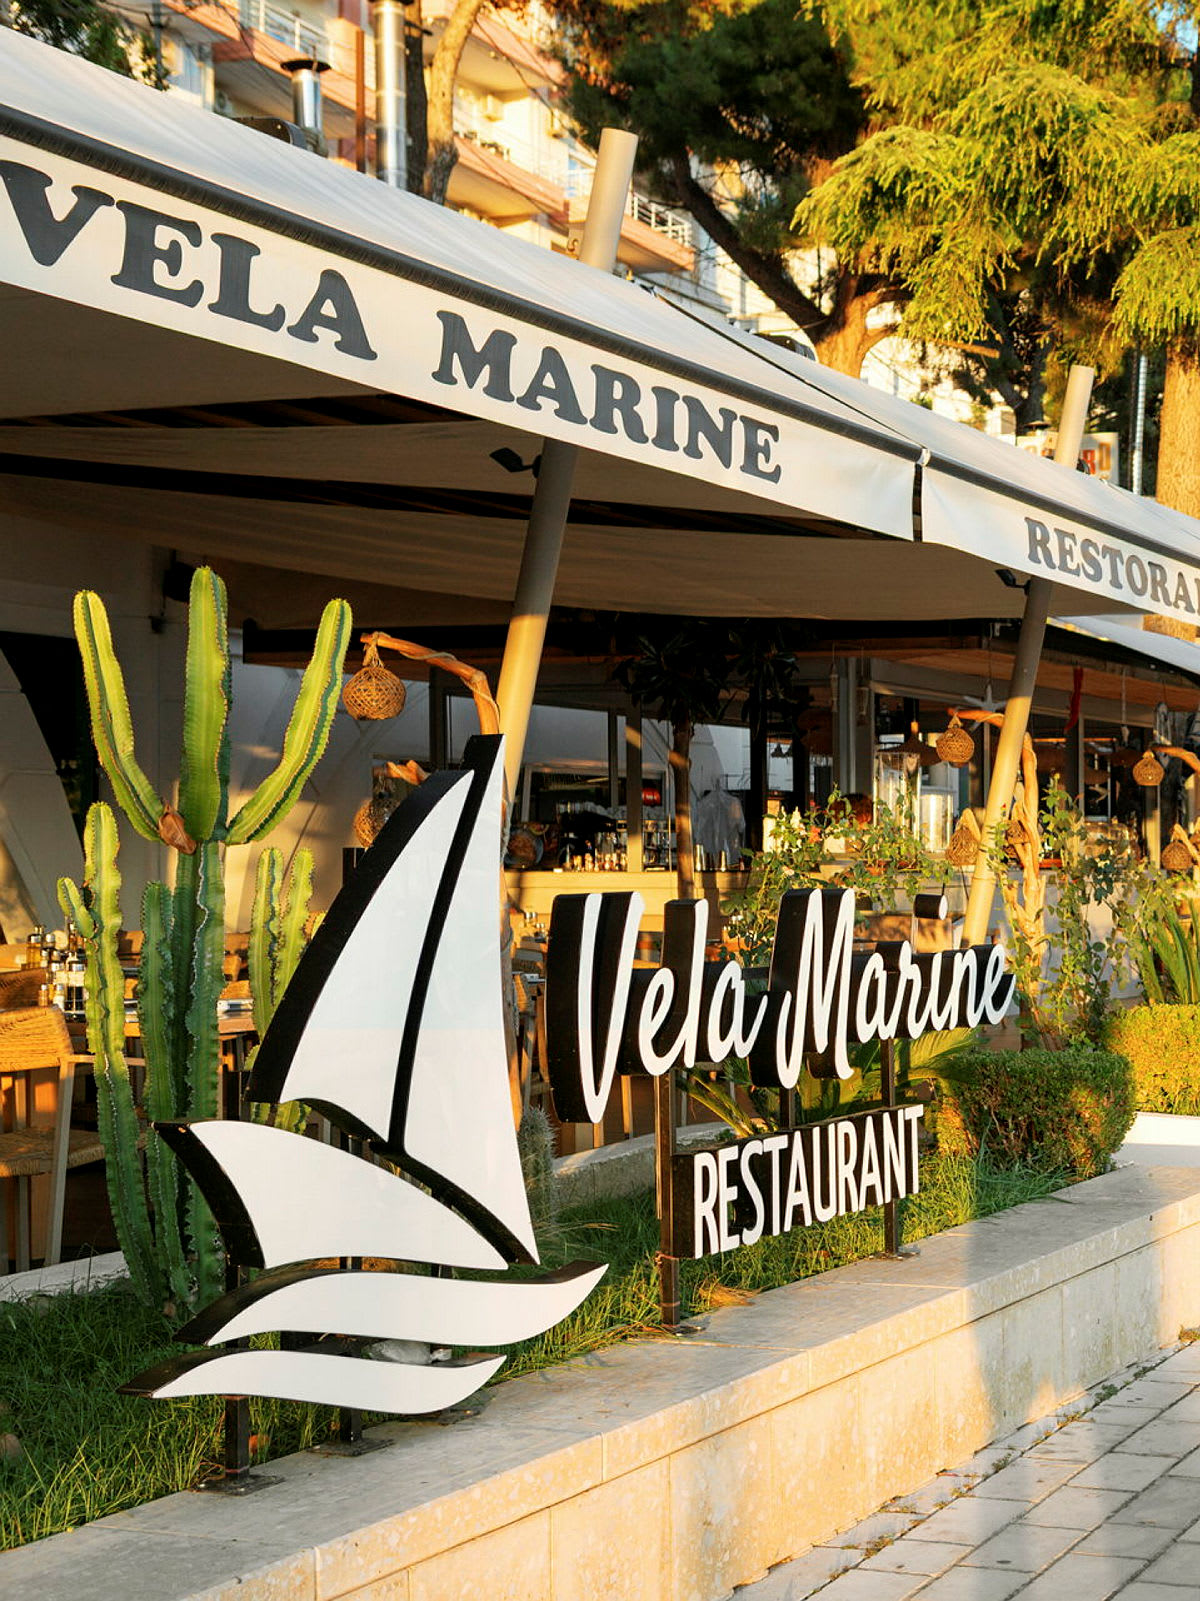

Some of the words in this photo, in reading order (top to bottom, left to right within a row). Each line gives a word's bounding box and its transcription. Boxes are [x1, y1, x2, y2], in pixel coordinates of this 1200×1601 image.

[0, 159, 378, 361] VELA
[432, 310, 782, 485] MARINE
[577, 891, 768, 1123] Vela
[776, 888, 1017, 1089] Marine
[693, 1104, 925, 1260] RESTAURANT
